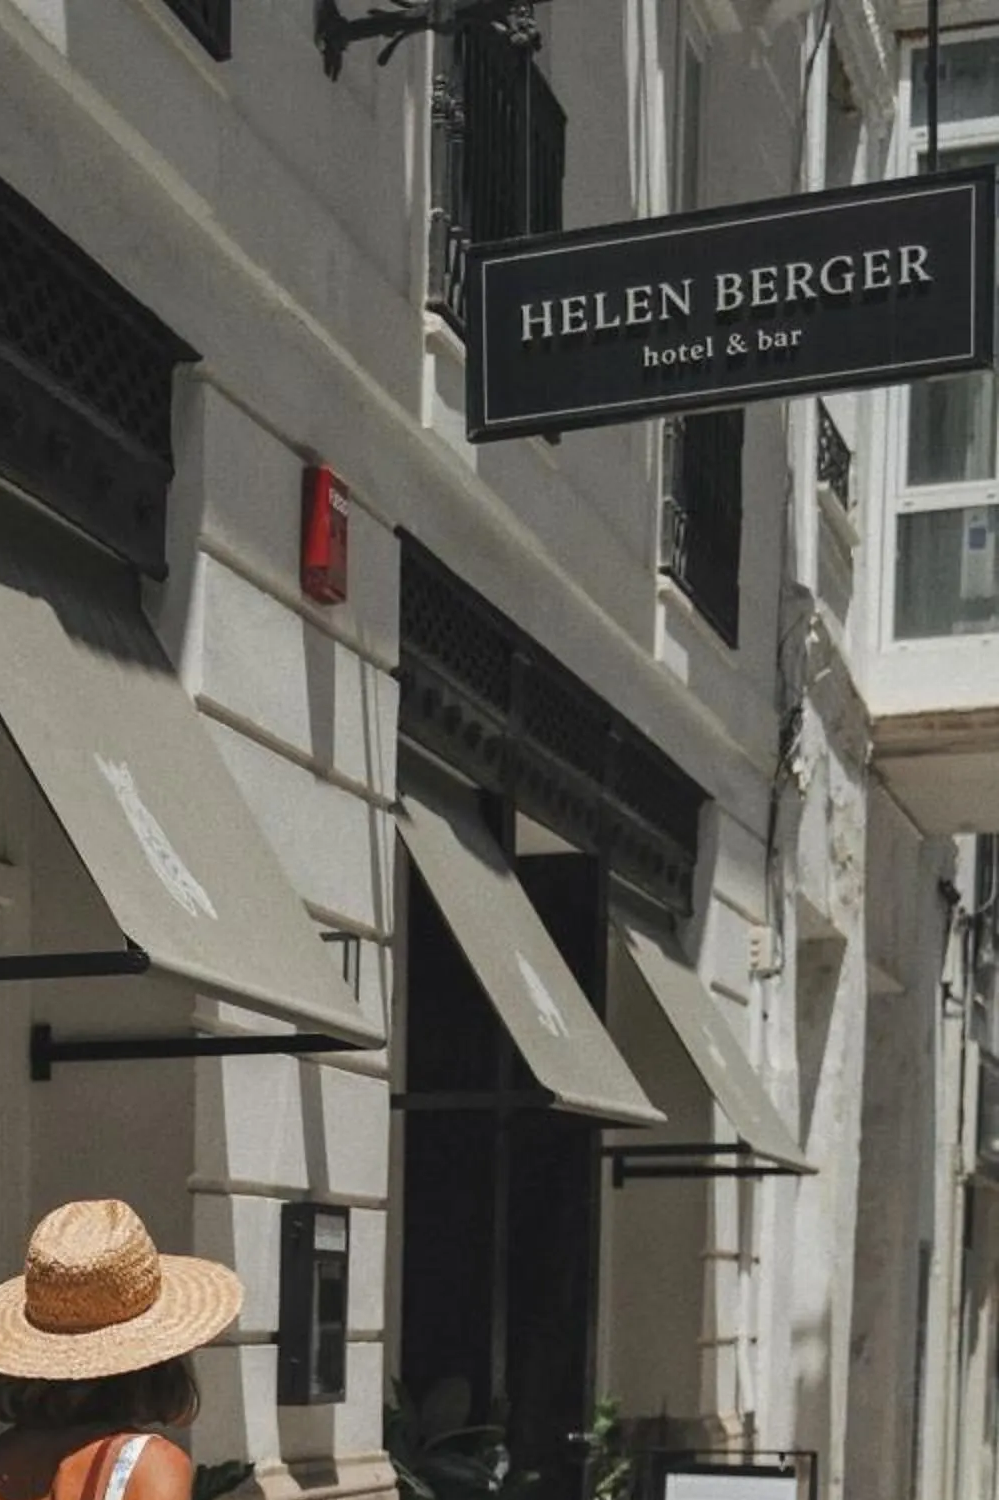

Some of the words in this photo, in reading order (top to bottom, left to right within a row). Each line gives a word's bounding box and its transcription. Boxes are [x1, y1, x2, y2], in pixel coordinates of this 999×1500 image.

[519, 277, 693, 342] HELEN
[715, 244, 934, 313] BERGER
[643, 335, 714, 367] hotel
[726, 332, 748, 356] &
[757, 328, 803, 352] bar
